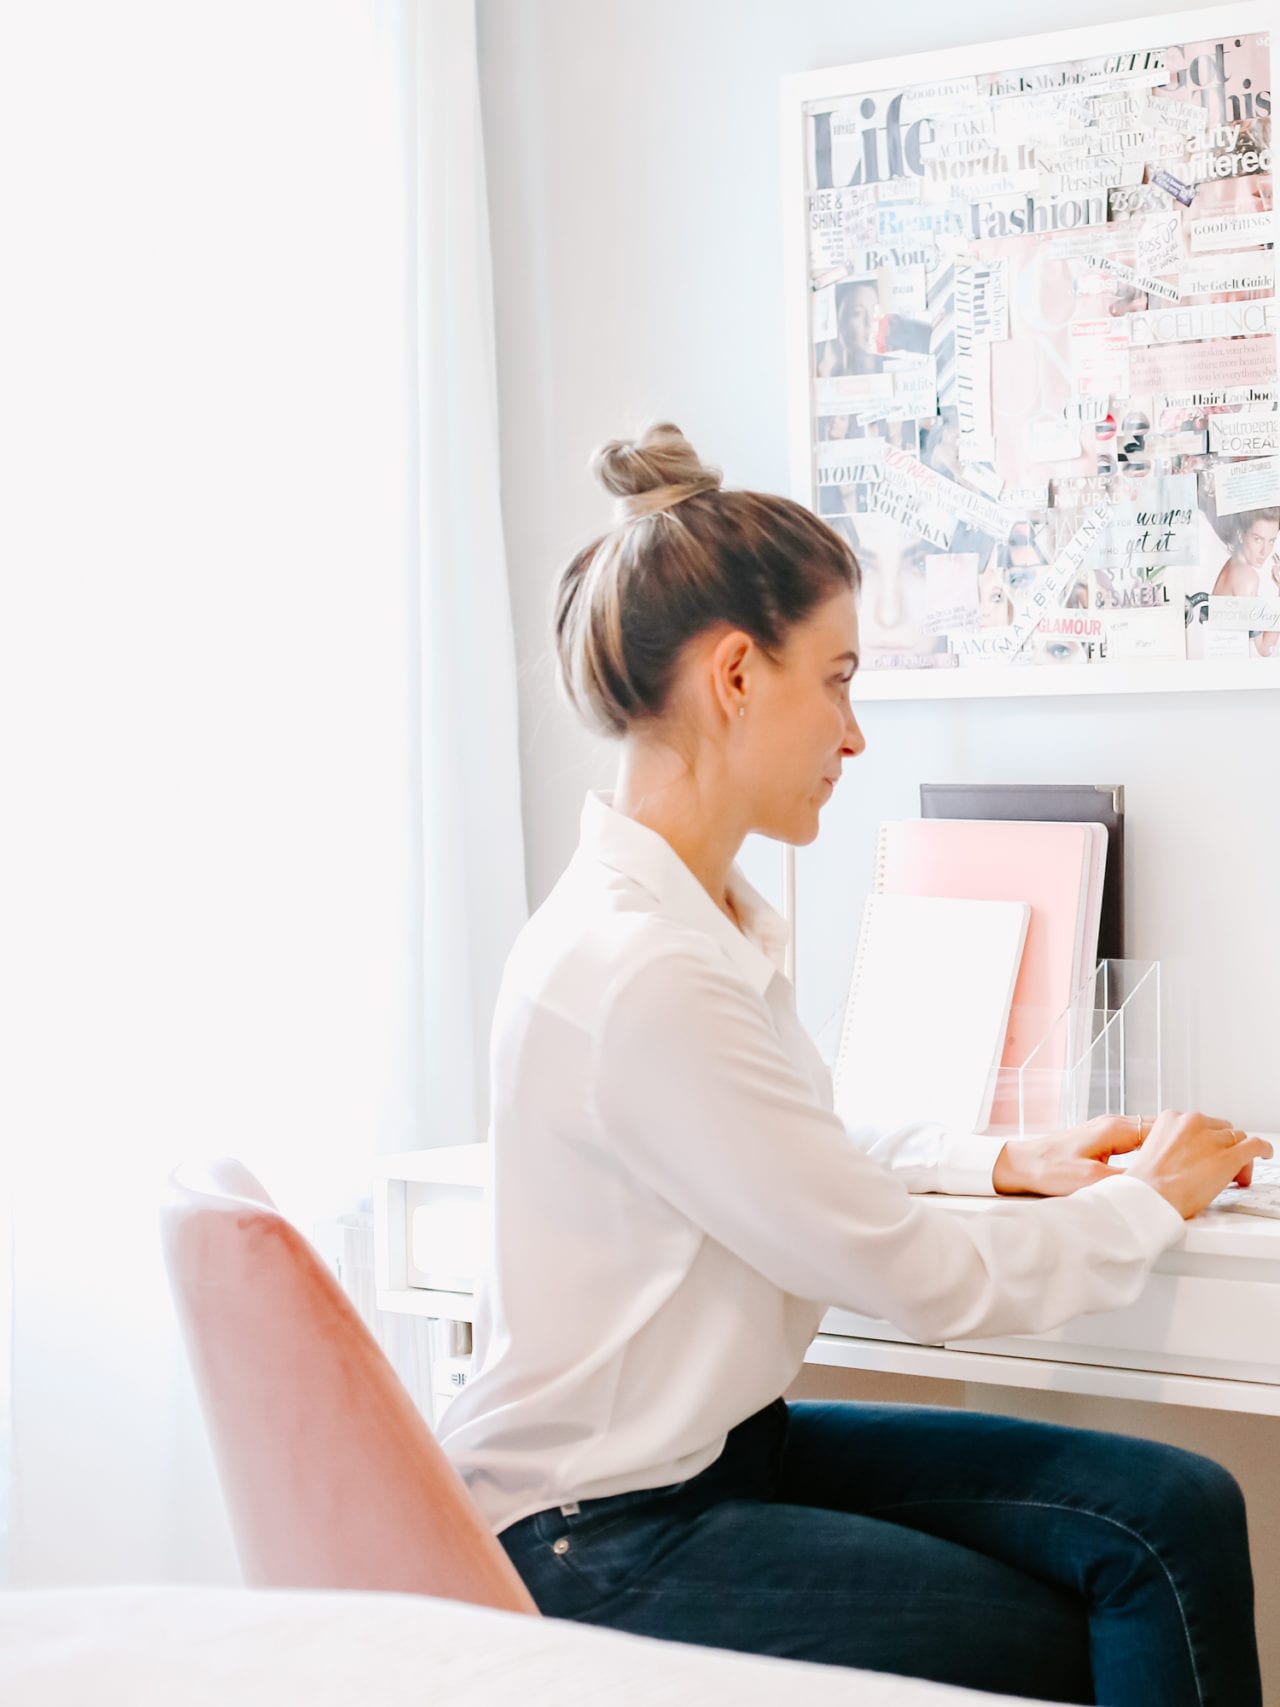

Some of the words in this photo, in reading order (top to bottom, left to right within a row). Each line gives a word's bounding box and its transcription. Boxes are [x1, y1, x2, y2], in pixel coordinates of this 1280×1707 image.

[1018, 77, 1033, 93] Is
[1192, 78, 1272, 124] This
[808, 92, 936, 190] Life
[1185, 124, 1241, 153] auty
[924, 147, 1009, 183] Worth
[1060, 164, 1122, 192] Persisted
[809, 193, 832, 212] RISE
[834, 189, 843, 210] &
[811, 211, 844, 231] SHINE
[969, 191, 1105, 241] Fashion
[1193, 222, 1228, 236] GOOD
[865, 250, 889, 271] Be
[1192, 280, 1209, 293] The
[1241, 274, 1272, 289] Guide
[818, 463, 881, 485] WOMEN
[1036, 617, 1102, 636] GLAMOUR
